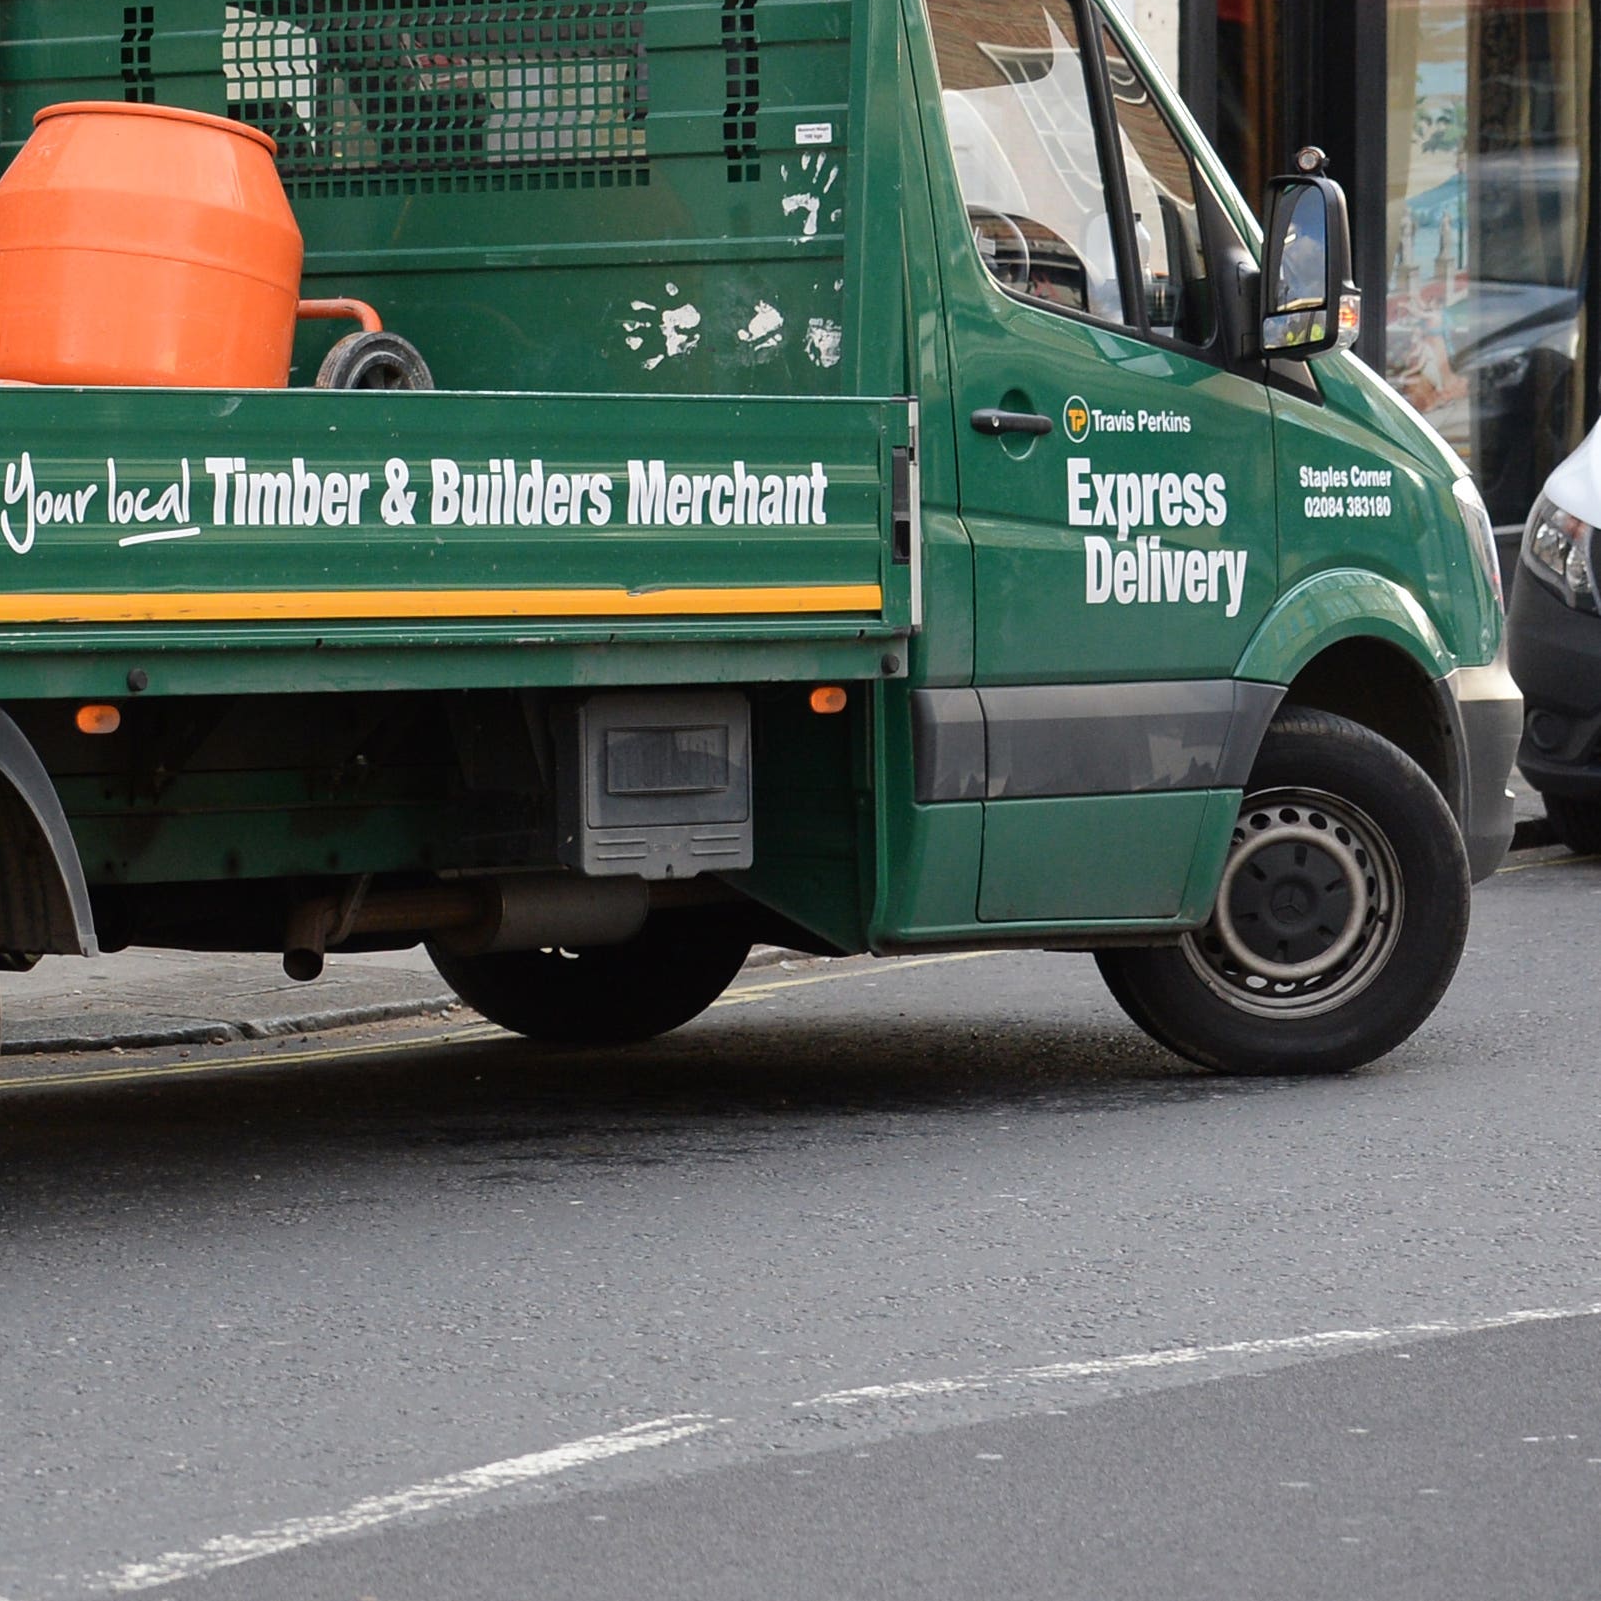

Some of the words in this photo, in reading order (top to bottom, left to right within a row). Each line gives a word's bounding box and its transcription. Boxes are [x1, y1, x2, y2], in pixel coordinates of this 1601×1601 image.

[1068, 409, 1087, 431] TP
[1091, 409, 1135, 432] Travis
[1138, 409, 1192, 433] Perkins
[2, 450, 98, 556] Your
[106, 456, 196, 542] local
[204, 456, 370, 527] Timber
[380, 458, 417, 526] &
[430, 454, 614, 528] Builders
[627, 456, 827, 527] Merchant
[1067, 457, 1227, 541] Express
[1299, 466, 1349, 492] Staples
[1351, 466, 1392, 488] Corner
[1304, 496, 1344, 518] 02084
[1347, 496, 1391, 518] 383180
[1084, 535, 1247, 618] Delivery
